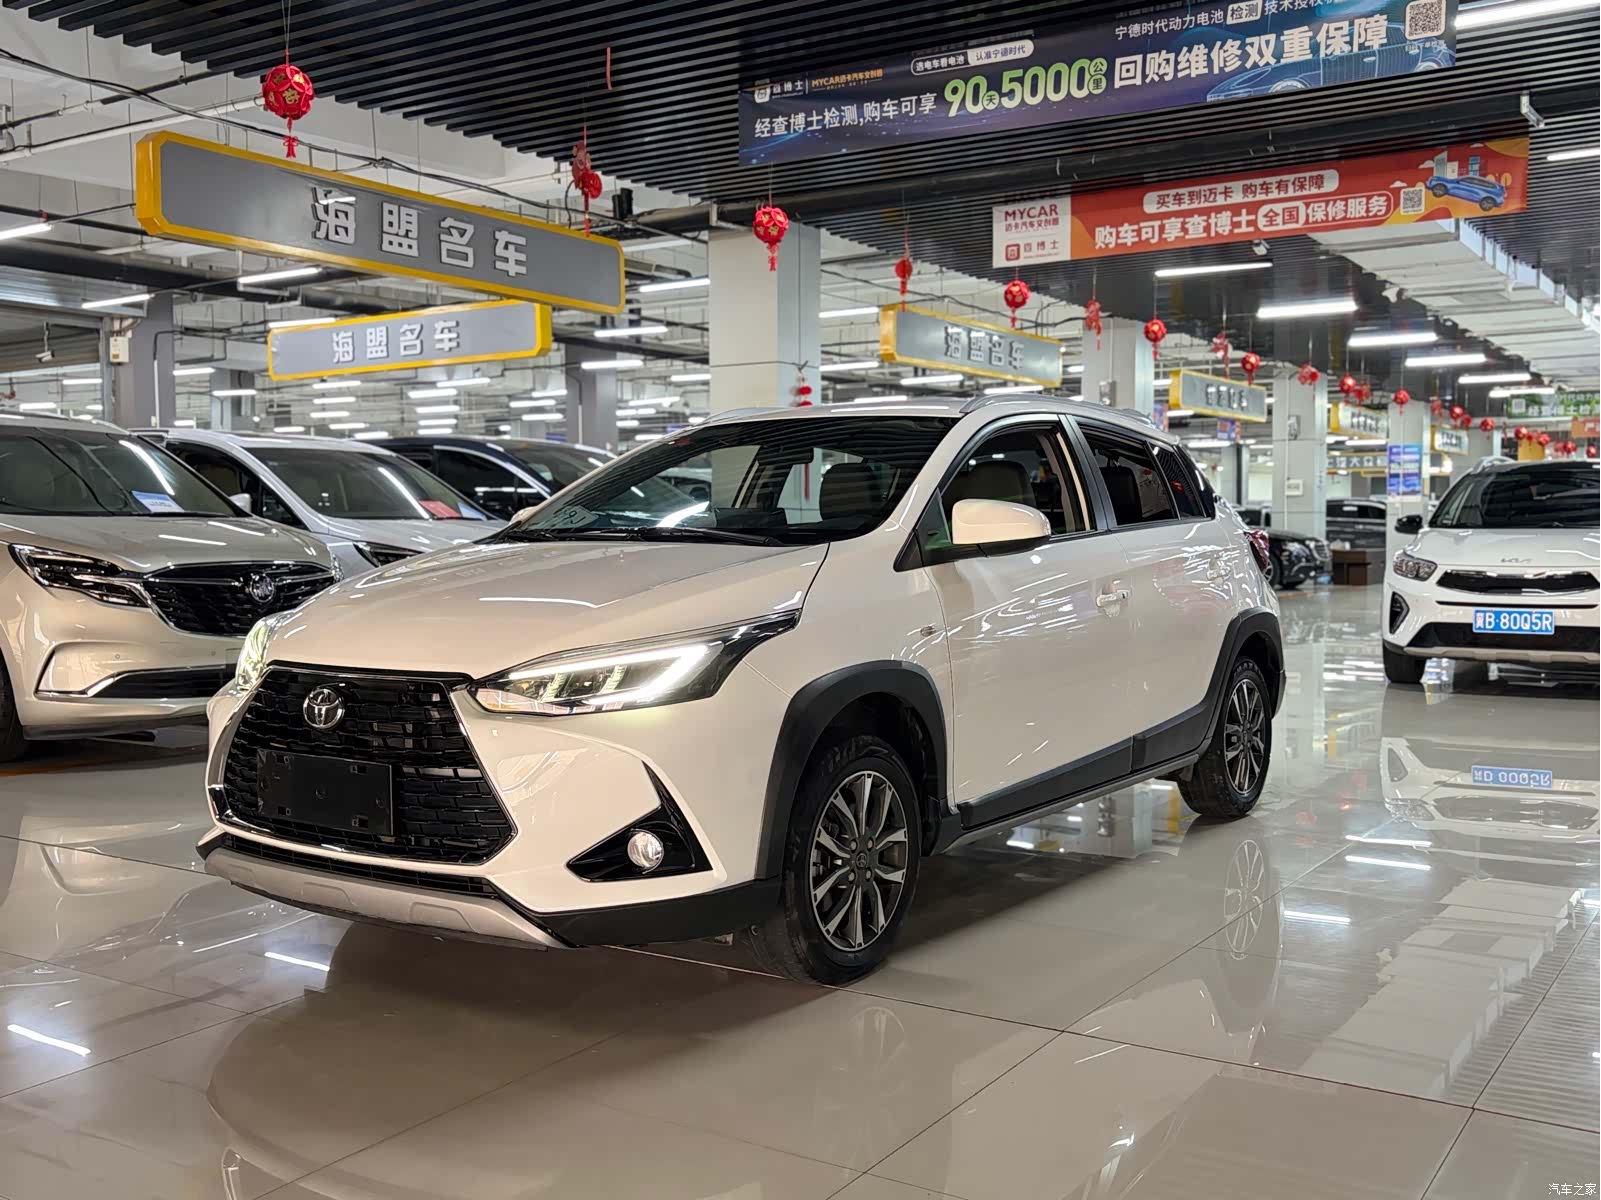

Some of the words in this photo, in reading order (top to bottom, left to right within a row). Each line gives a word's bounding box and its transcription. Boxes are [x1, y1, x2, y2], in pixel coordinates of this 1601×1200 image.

[976, 44, 1026, 61] 认准宁德时代
[1114, 14, 1388, 88] 回购维修双重保障
[1156, 187, 1235, 210] 买车到迈卡
[1241, 174, 1326, 198] 购车有保障
[312, 186, 528, 277] 海盟名车
[1004, 203, 1059, 222] MYCAR
[333, 320, 459, 363] 海盟名车
